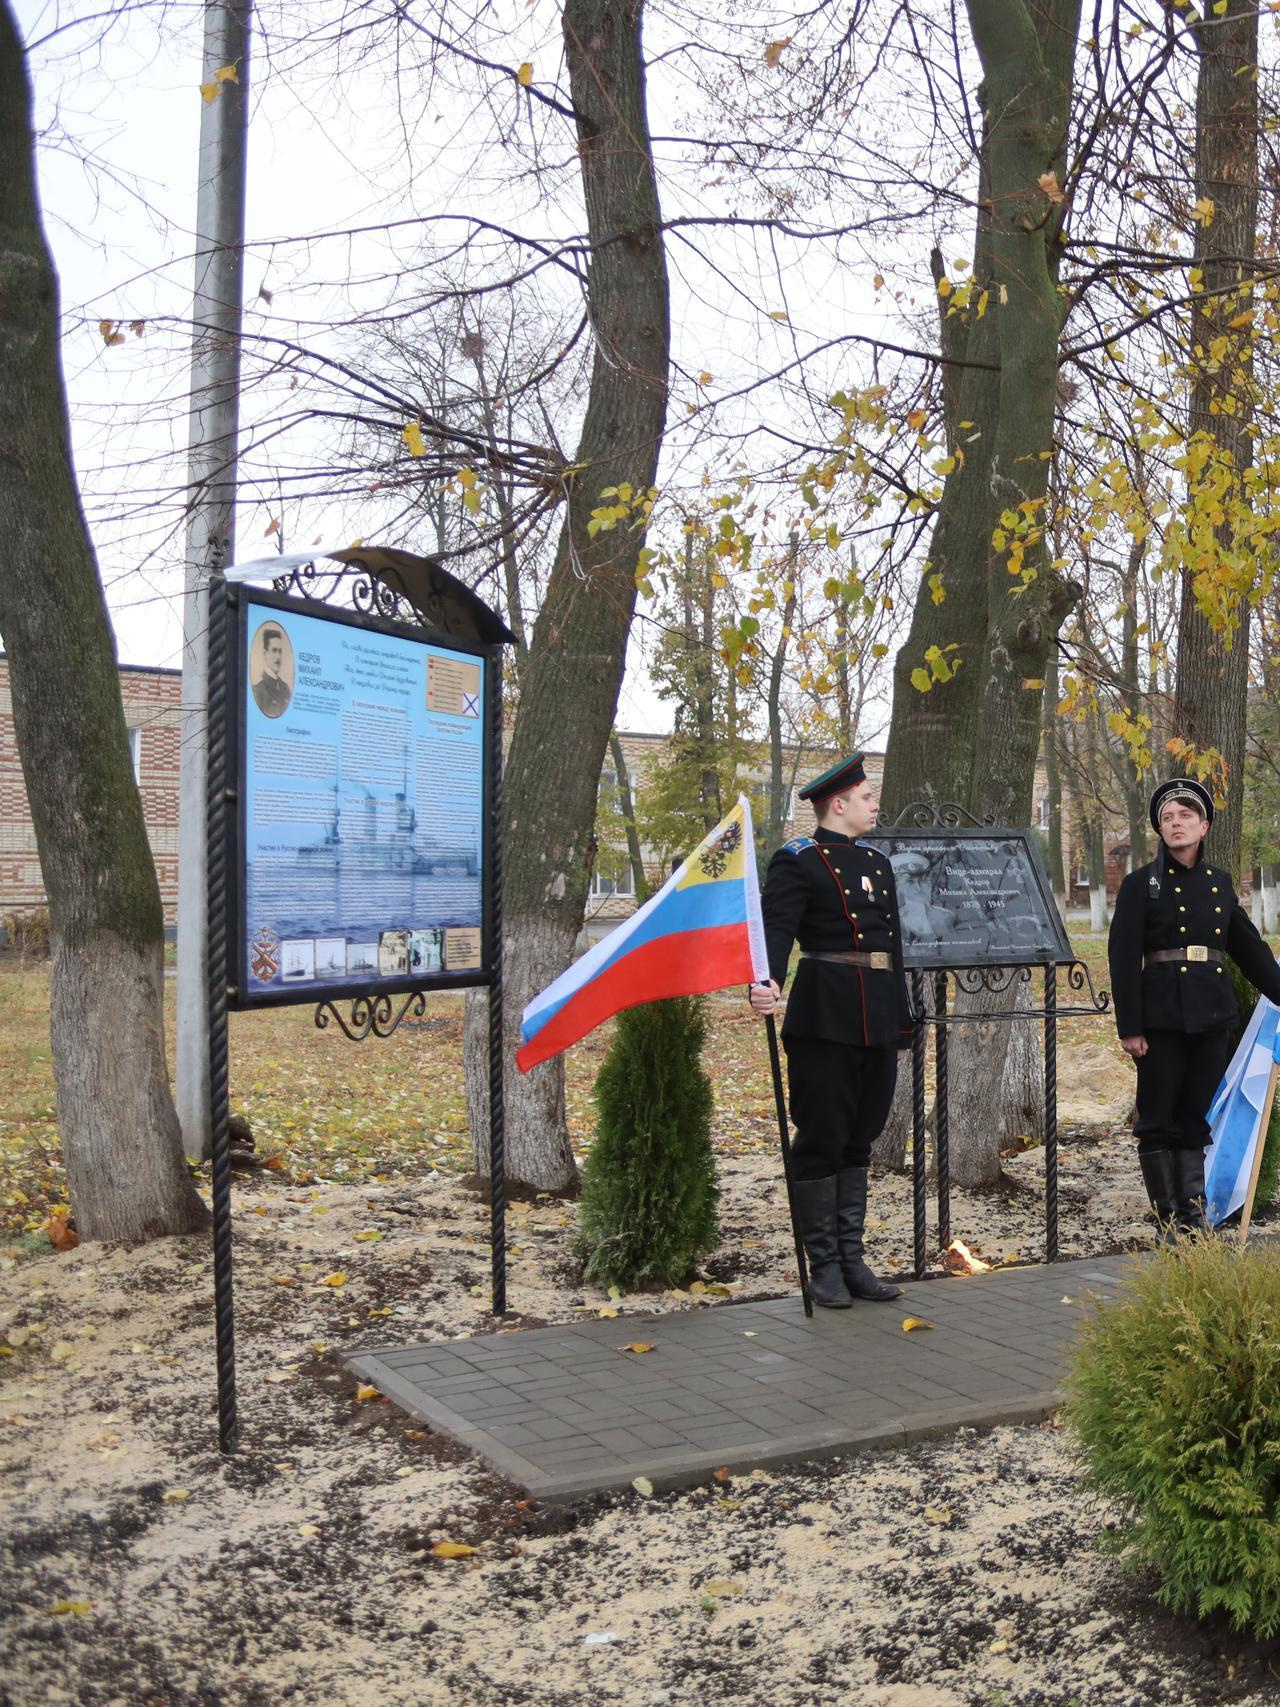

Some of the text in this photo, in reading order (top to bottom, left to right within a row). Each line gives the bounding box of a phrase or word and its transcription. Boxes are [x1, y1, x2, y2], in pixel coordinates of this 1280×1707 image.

[298, 652, 320, 664] КЕДРОВ
[298, 664, 322, 676] МИХАИЛ
[298, 676, 345, 692] АЛЕКСАНДРОВИЧ
[945, 866, 1003, 877] Вице-адмирал
[939, 887, 1020, 896] Михаил Александрович
[988, 900, 1005, 908] 1945
